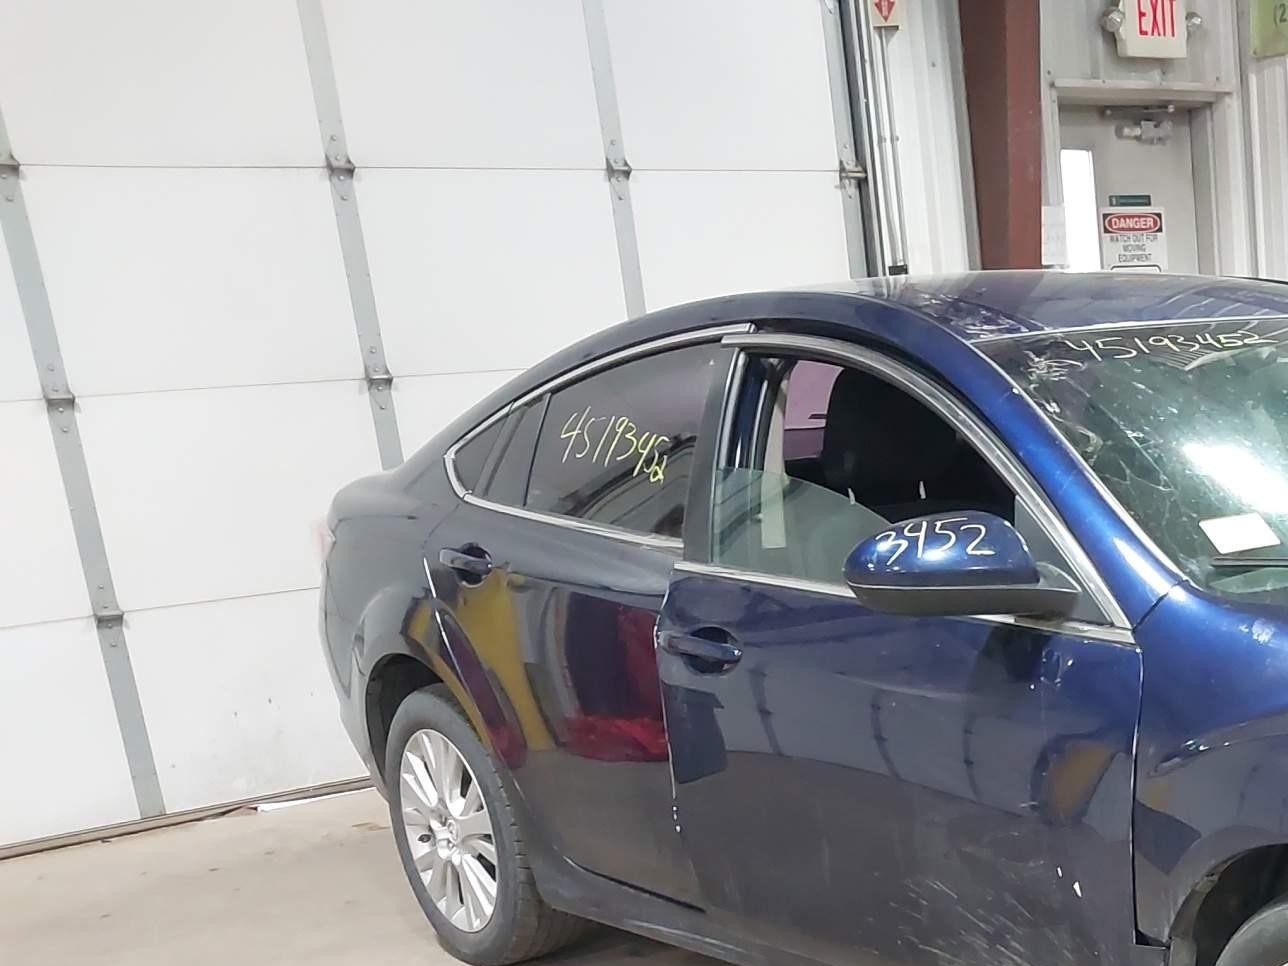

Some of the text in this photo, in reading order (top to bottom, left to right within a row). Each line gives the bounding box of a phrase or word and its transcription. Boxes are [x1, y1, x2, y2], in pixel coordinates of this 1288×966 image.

[1137, 0, 1175, 37] EXIT
[1111, 217, 1155, 229] DANGER
[1064, 330, 1279, 361] 45193452
[560, 406, 670, 485] 45193452
[876, 517, 996, 566] 3452
